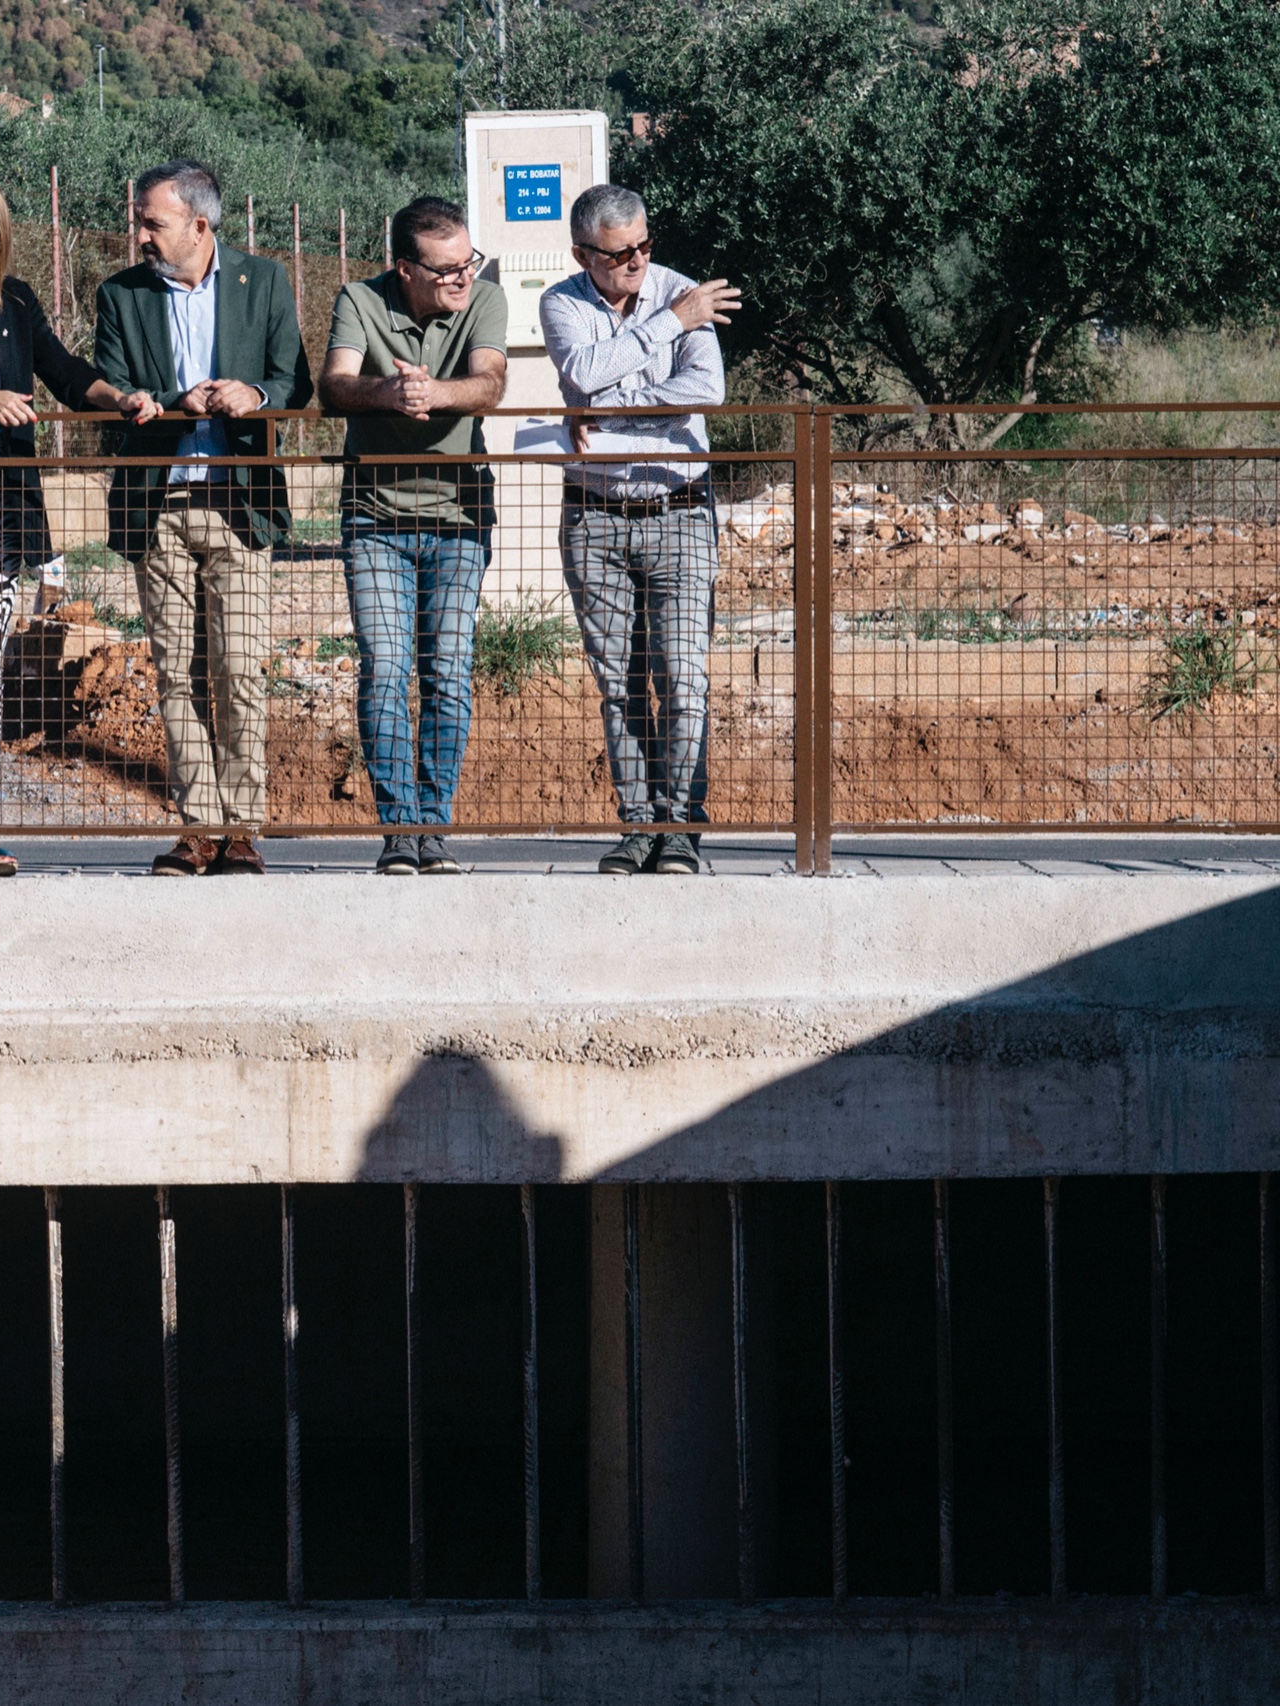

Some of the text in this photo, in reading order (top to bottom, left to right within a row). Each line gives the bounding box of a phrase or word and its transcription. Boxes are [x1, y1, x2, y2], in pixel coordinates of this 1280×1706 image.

[507, 169, 559, 179] C/ PIC BOBATAR
[518, 188, 529, 197] 214
[537, 188, 549, 196] PBJ
[534, 206, 551, 214] 12004
